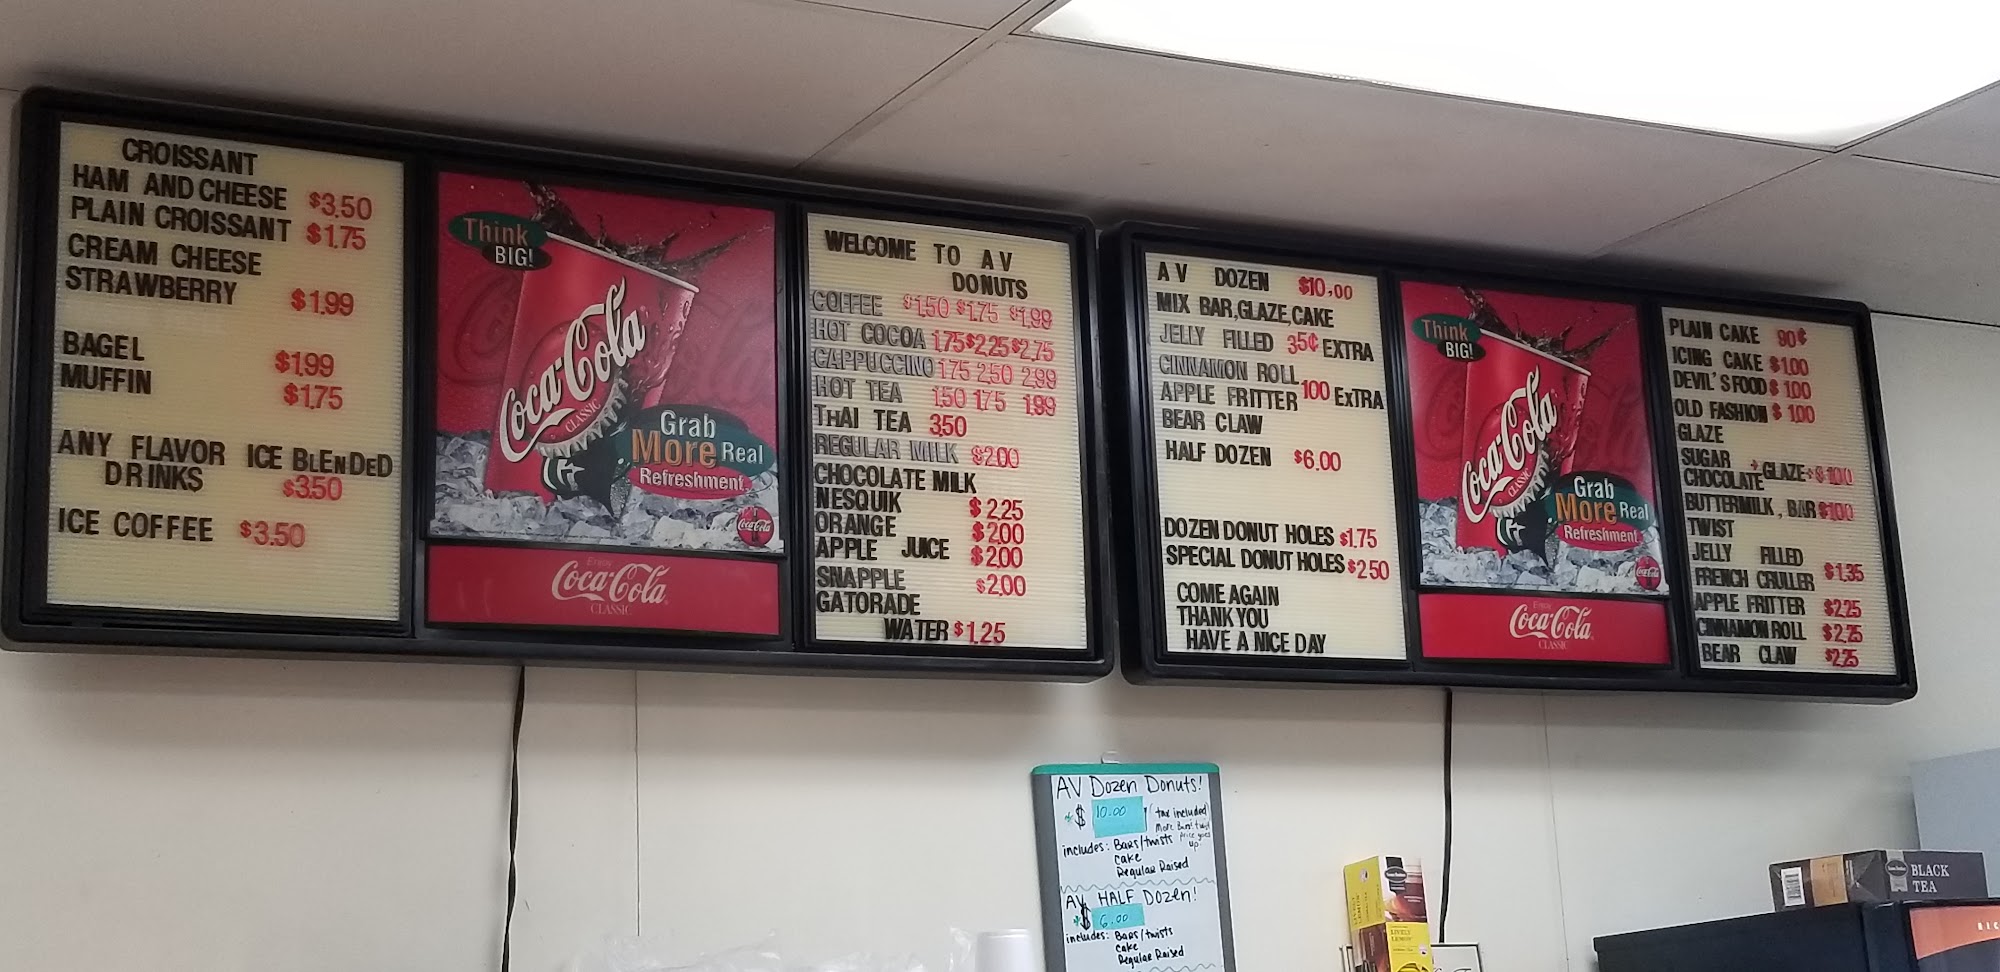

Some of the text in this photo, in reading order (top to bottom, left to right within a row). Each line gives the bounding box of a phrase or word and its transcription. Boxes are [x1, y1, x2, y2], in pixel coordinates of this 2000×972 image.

[122, 138, 258, 176] CROISSANT
[73, 163, 373, 221] HAM AND CHEESE $3.50
[71, 195, 367, 251] PLAIN CROISSANT $1.75
[463, 217, 529, 247] Think
[68, 233, 262, 276] CREAM CHEESE
[495, 245, 534, 268] BIG!
[824, 229, 961, 266] WELCOME TO
[65, 265, 355, 317] STRAWBERRY $1.99
[952, 271, 1028, 299] DONUTS
[1214, 266, 1270, 292] DOZEN
[812, 289, 883, 317] COFFEE
[1156, 291, 1190, 314] MIX
[813, 318, 927, 350] HOT COCOA
[1159, 323, 1206, 346] JELLY
[1223, 328, 1274, 352] FILLED
[1322, 338, 1375, 362] EXTRA
[1421, 318, 1469, 342] Think
[1669, 318, 1761, 345] PLAIN CAKE
[62, 330, 145, 361] BAGEL
[1445, 342, 1474, 360] BIG!
[1672, 346, 1713, 367] ICING
[1723, 350, 1764, 372] CAKE
[499, 276, 646, 463] Coca-Cola
[813, 347, 935, 379] CAPPUCCINO
[1159, 354, 1300, 385] CINNAMON ROLL
[60, 363, 151, 395] MUFFIN
[815, 375, 903, 403] HOT TEA
[1160, 381, 1216, 405] APPLE
[1227, 386, 1299, 411] FRITTER
[565, 397, 603, 433] CLASSIC
[660, 409, 717, 439] Grab
[873, 409, 912, 433] TEA
[1162, 408, 1263, 435] BEAR CLAW
[1674, 398, 1769, 424] OLD FASHION
[1462, 364, 1558, 523] Coca-Cola
[1677, 423, 1725, 444] GLAZE
[58, 429, 112, 456] ANY
[131, 434, 225, 466] FLAVOR
[247, 443, 283, 470] ICE
[632, 428, 764, 469] More Real
[814, 433, 959, 464] REGULAR MILK
[1165, 439, 1342, 472] HALF DOZEN $6.00
[1681, 447, 1732, 469] SUGAR
[105, 460, 204, 492] DRINKS
[814, 462, 978, 494] CHOCOLATE MILK
[1507, 468, 1532, 498] CLASSIC
[1683, 468, 1765, 491] CHOCOLATE
[1762, 461, 1806, 483] GLAZE
[815, 487, 902, 513] NESQUIK
[1573, 475, 1615, 501] Grab
[1555, 492, 1650, 525] More Real
[1684, 492, 1817, 519] BUTTERMILK BAR
[58, 507, 306, 548] ICE COFFEE $3.50
[815, 510, 897, 537] ORANGE
[1163, 517, 1378, 549] DOZEN DONUT HOLES $1.75
[1687, 517, 1735, 538] TWIST
[815, 536, 950, 561] APPLE JUICE
[1165, 545, 1346, 574] SPECIAL DONUT HOLES
[1692, 542, 1804, 567] JELLY FILLED
[552, 560, 672, 605] Coca-Cola
[816, 566, 906, 591] SNAPPLE
[1694, 566, 1816, 592] FRENCH CRULLER
[816, 591, 921, 616] GATORADE
[1176, 581, 1280, 607] COME AGAIN
[1694, 593, 1806, 616] APPLE FRITTER
[590, 603, 633, 616] CLASSIC
[1176, 605, 1270, 629] THANK YOU
[1509, 603, 1593, 640] Coca-Cola
[883, 617, 1006, 645] WATER $1.25
[1186, 628, 1327, 654] HAVE A NICE DAY
[1696, 617, 1808, 641] CINNAMON ROLL
[1538, 639, 1570, 651] CLASSIC
[1701, 643, 1797, 666] BEAR CLAW
[1056, 775, 1203, 800] AV Dozen Donuts!
[1095, 805, 1127, 819] 10.00
[1061, 841, 1110, 859] includes:
[1159, 856, 1190, 875] Raised
[1910, 863, 1950, 878] BLACK
[1098, 886, 1198, 907] HALF Dozen!
[1912, 880, 1938, 893] TEA
[1066, 930, 1110, 944] includes:
